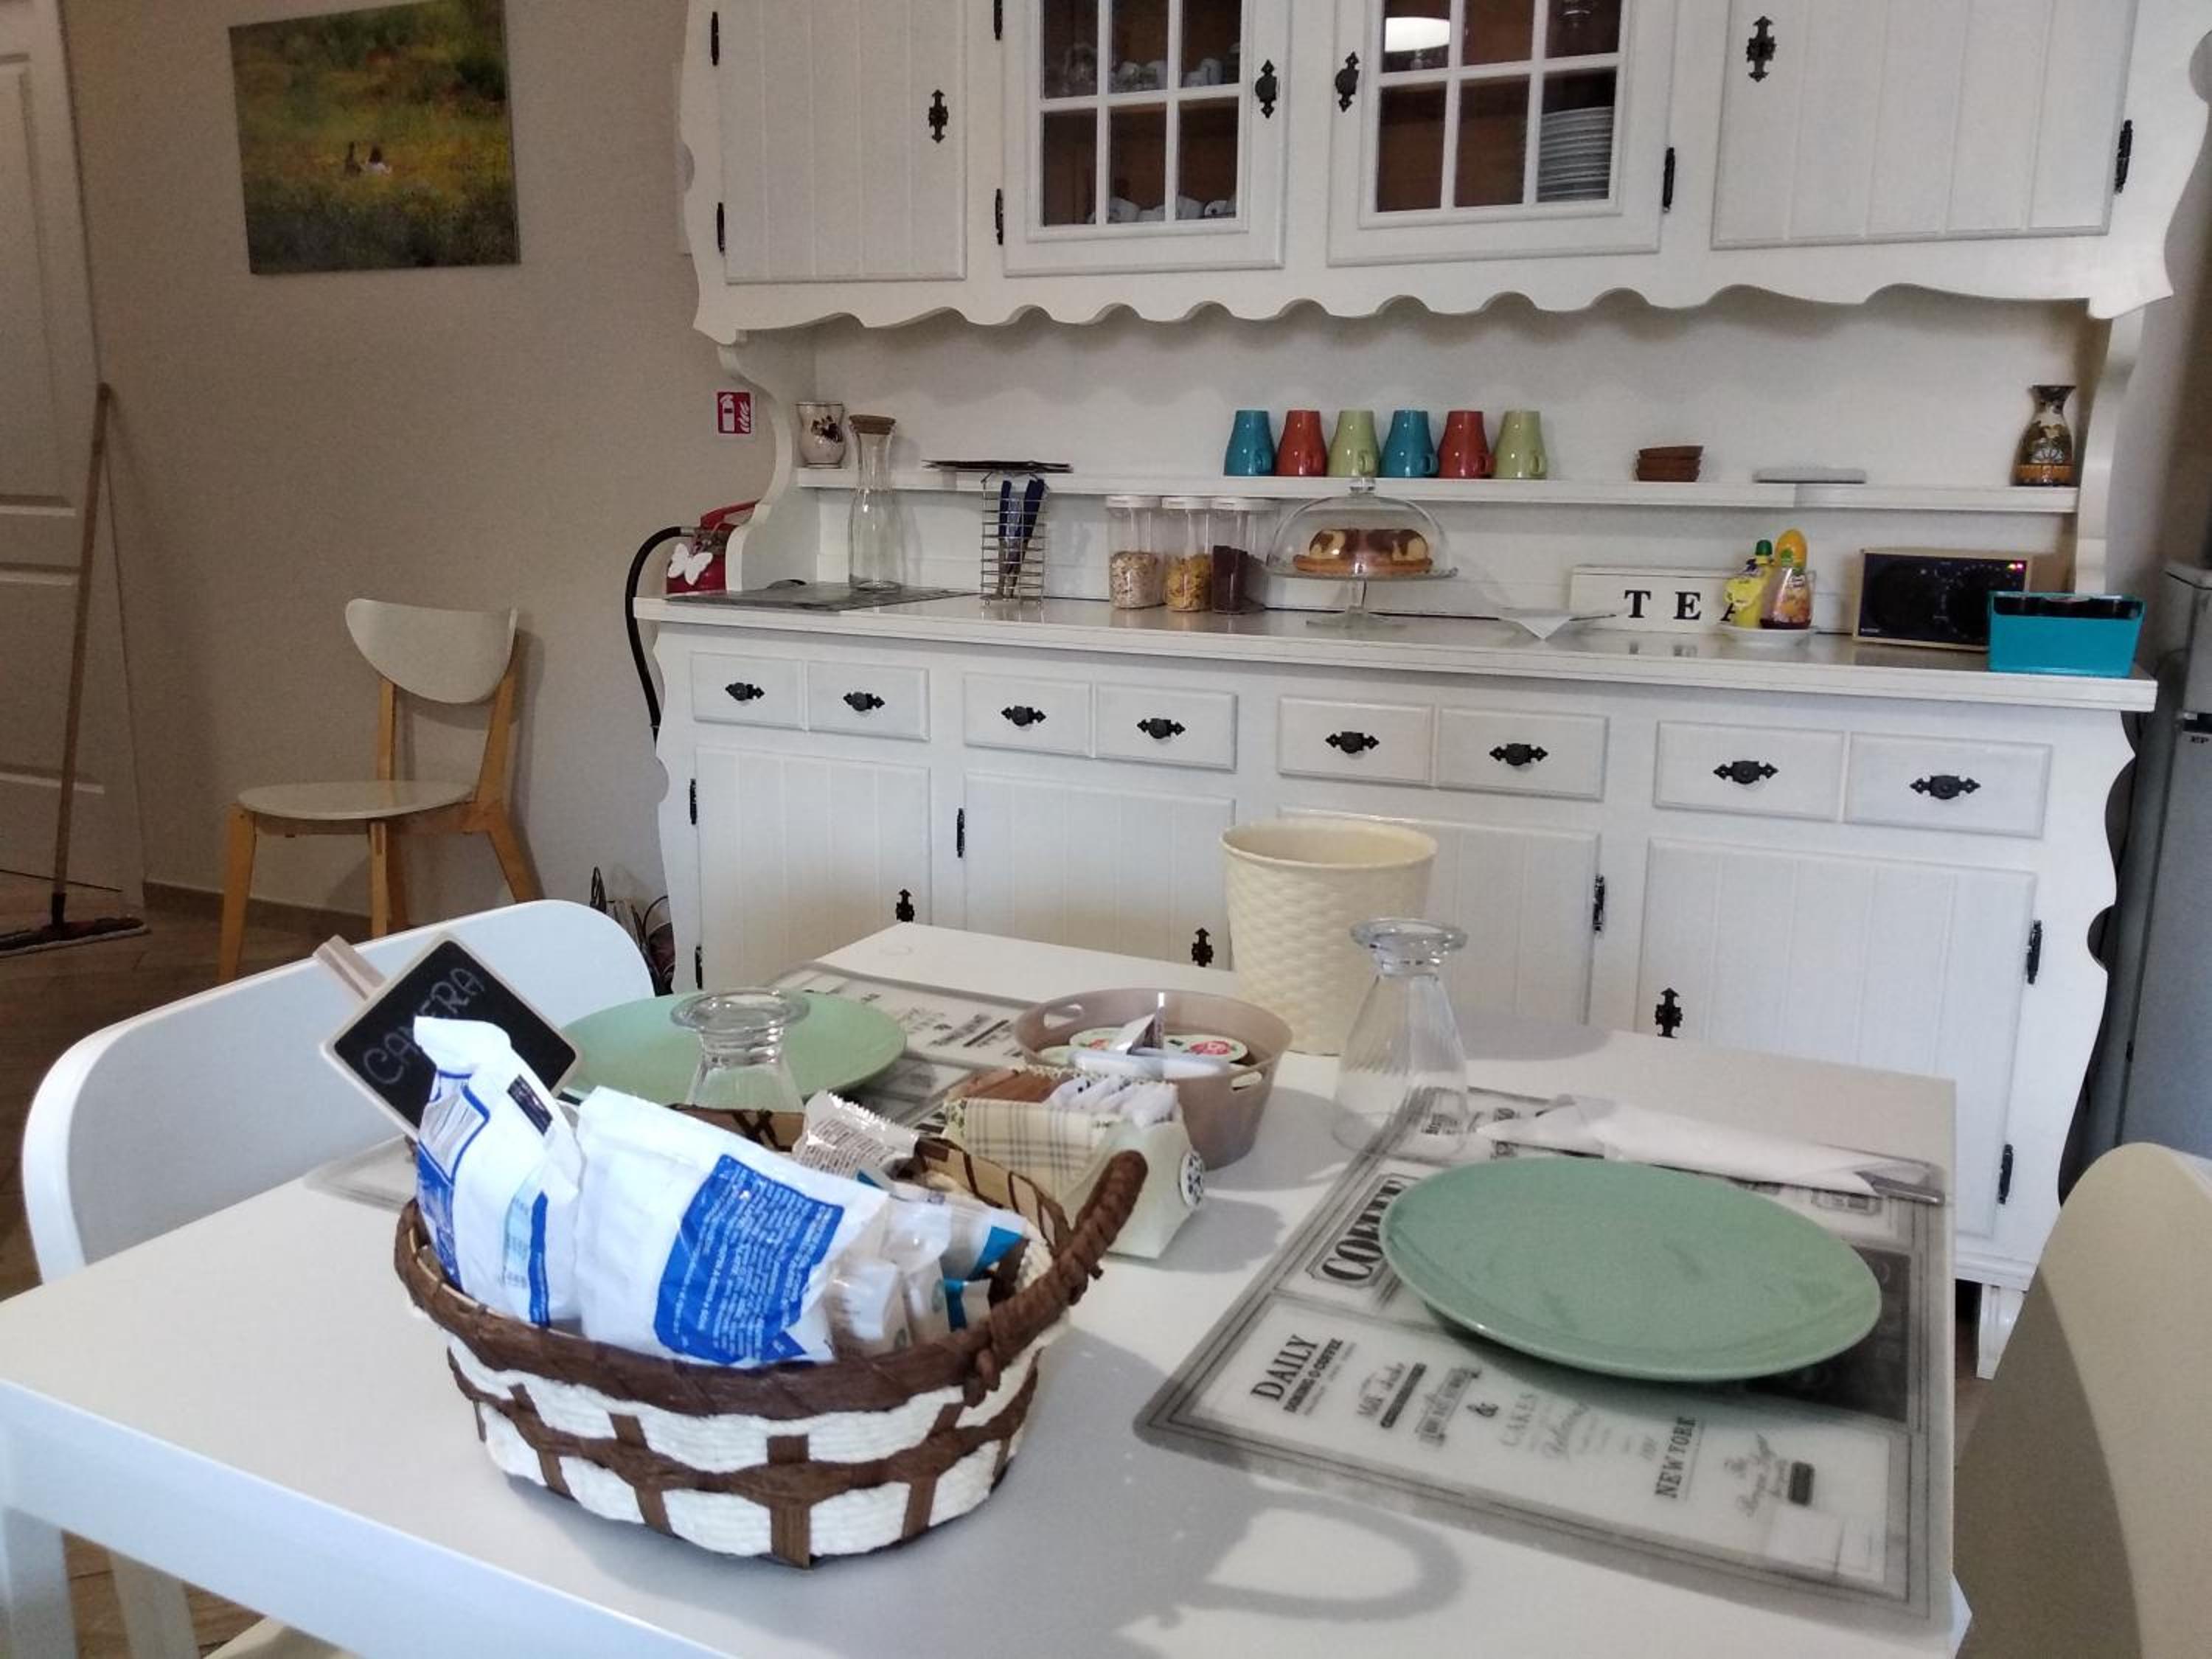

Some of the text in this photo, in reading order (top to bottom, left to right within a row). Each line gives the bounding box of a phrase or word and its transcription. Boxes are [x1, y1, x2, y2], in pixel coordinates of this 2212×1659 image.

[364, 967, 484, 1084] CARA
[1251, 1334, 1318, 1402] DAILY
[1655, 1416, 1697, 1499] NEW YORK
